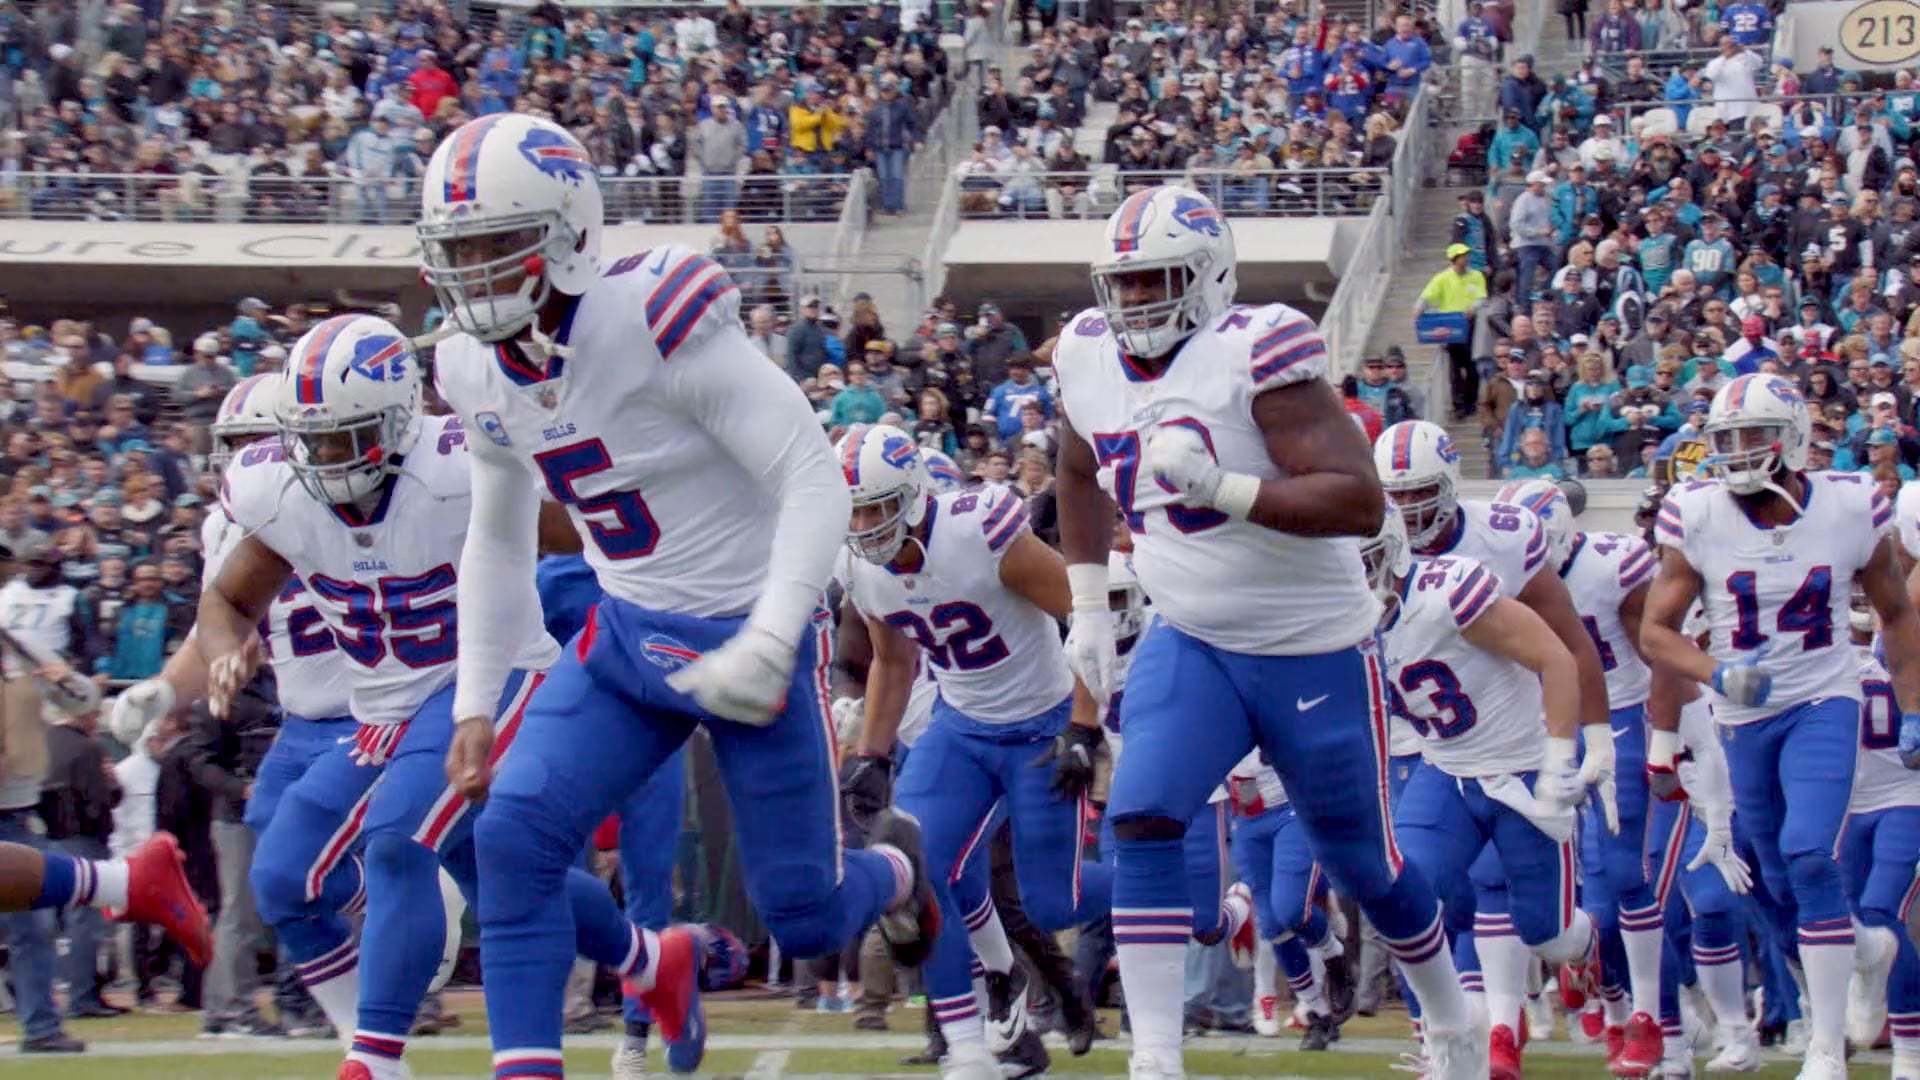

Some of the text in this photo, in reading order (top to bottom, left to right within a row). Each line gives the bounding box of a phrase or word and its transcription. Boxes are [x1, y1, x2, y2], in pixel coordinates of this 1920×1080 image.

[1734, 13, 1758, 32] 22
[1858, 15, 1915, 47] 213
[1829, 226, 1847, 251] 5
[1692, 249, 1721, 272] 90
[543, 423, 576, 440] BILLS
[534, 437, 661, 560] 5
[9, 603, 50, 630] 27
[1726, 565, 1833, 651] 14
